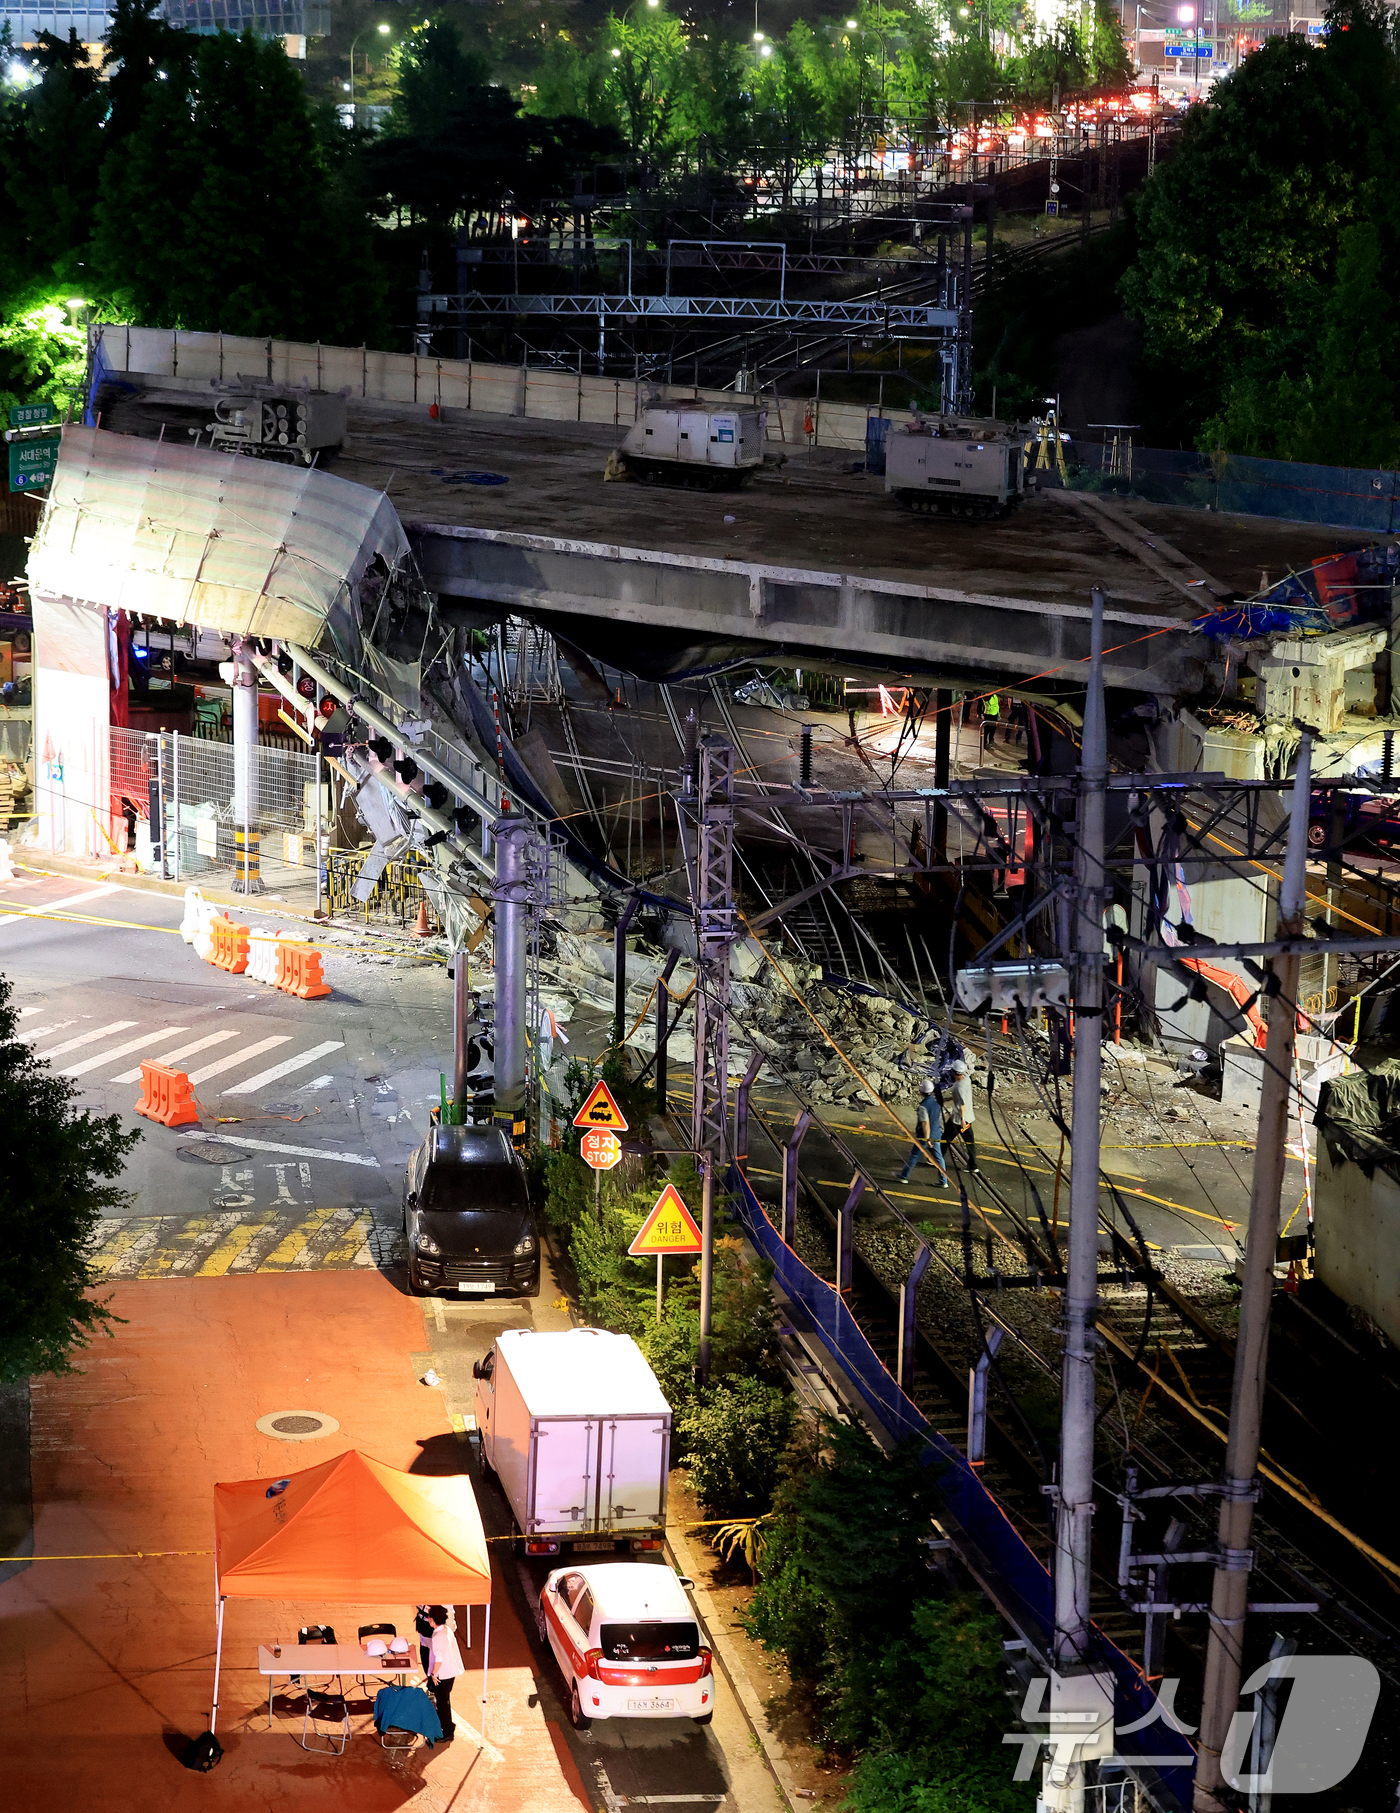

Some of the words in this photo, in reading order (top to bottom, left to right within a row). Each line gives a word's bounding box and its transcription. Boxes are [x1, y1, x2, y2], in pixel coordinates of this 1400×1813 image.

[17, 407, 48, 421] 경찰청앞
[19, 446, 51, 462] 서대문역
[587, 1135, 615, 1151] 정지
[586, 1151, 615, 1164] STOP
[212, 1162, 314, 1208] 정지
[656, 1221, 682, 1235] 위험
[651, 1235, 686, 1243] DANGER
[650, 1700, 670, 1709] 3664
